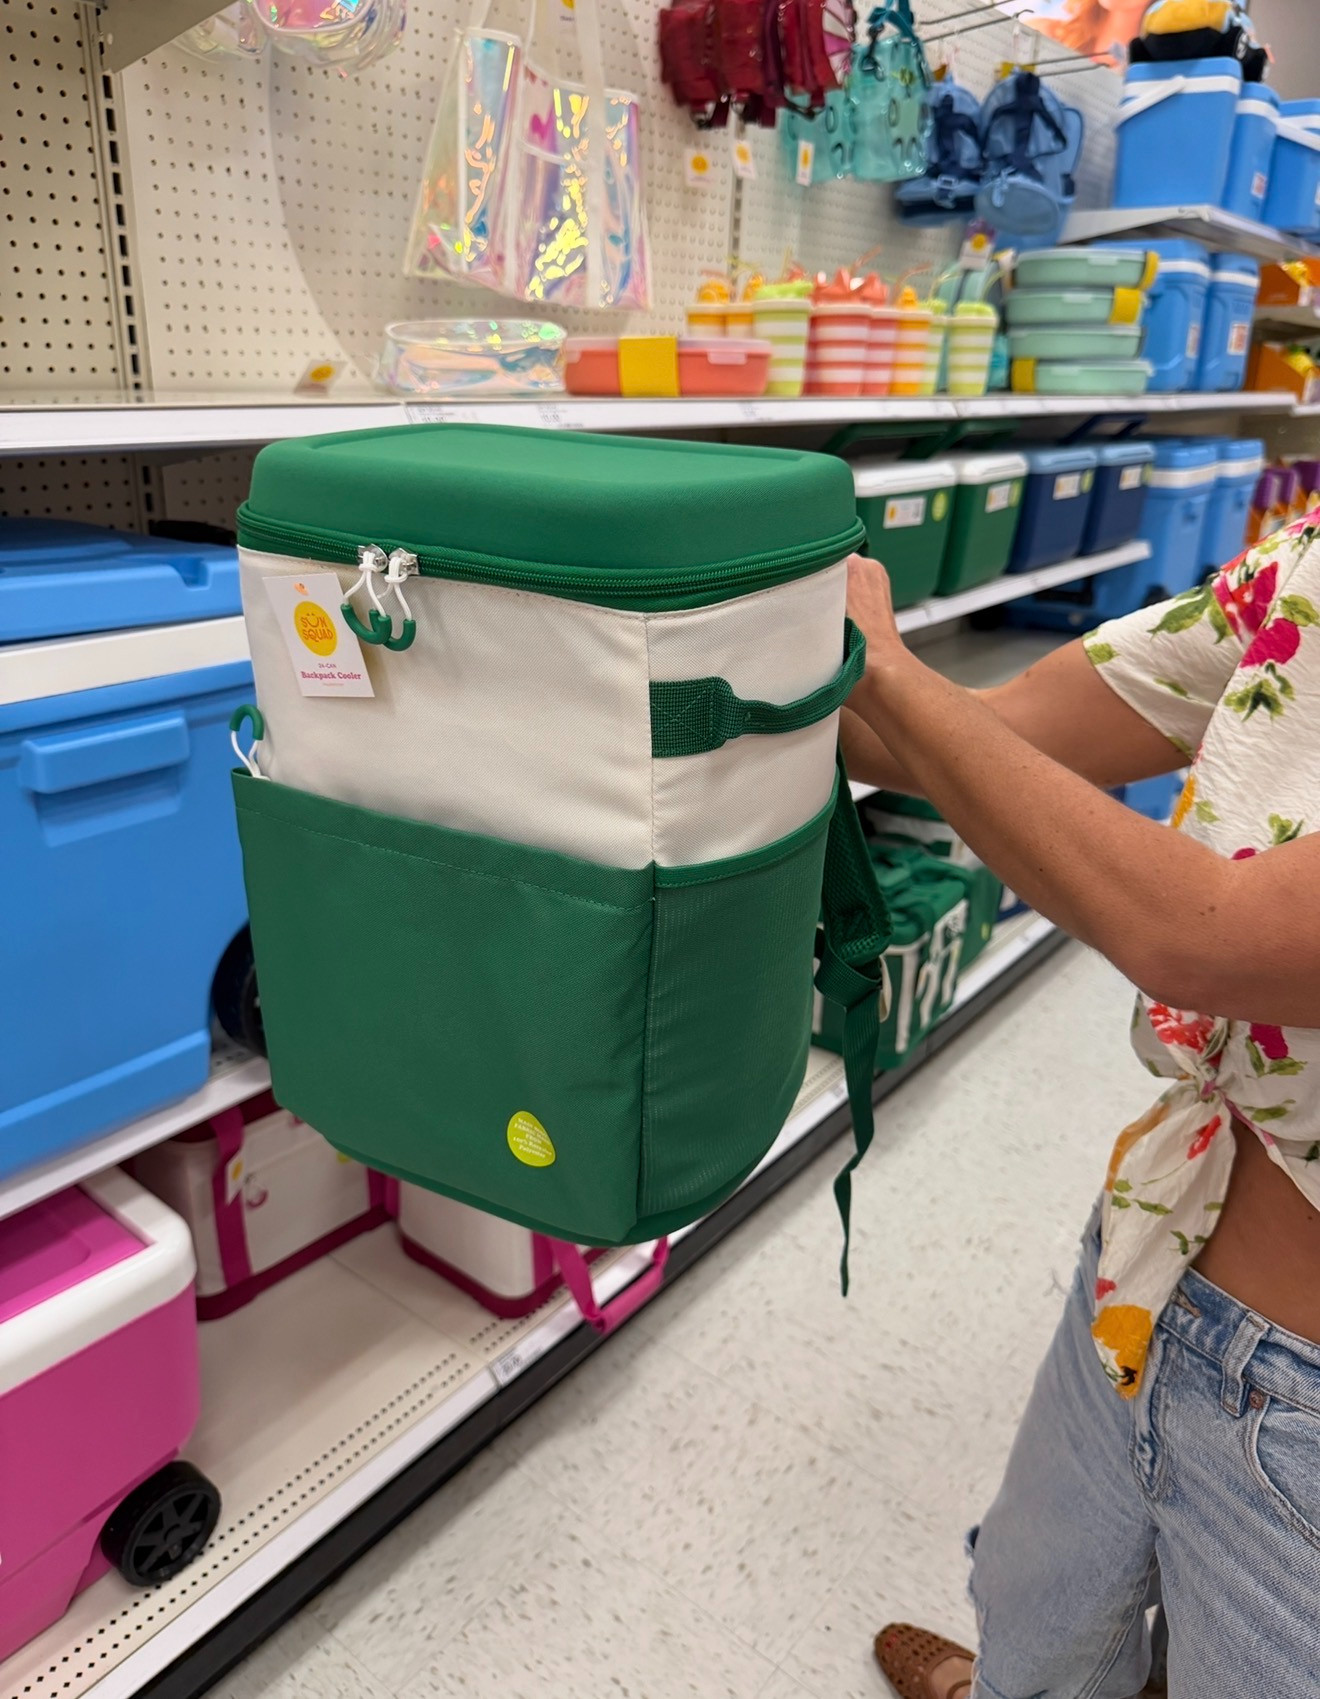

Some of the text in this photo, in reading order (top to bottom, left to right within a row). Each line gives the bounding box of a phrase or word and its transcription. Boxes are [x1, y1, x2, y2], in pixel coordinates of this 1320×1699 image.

[301, 615, 327, 628] SUN
[303, 629, 334, 643] SQUAD
[301, 671, 362, 680] Backpack Cooler
